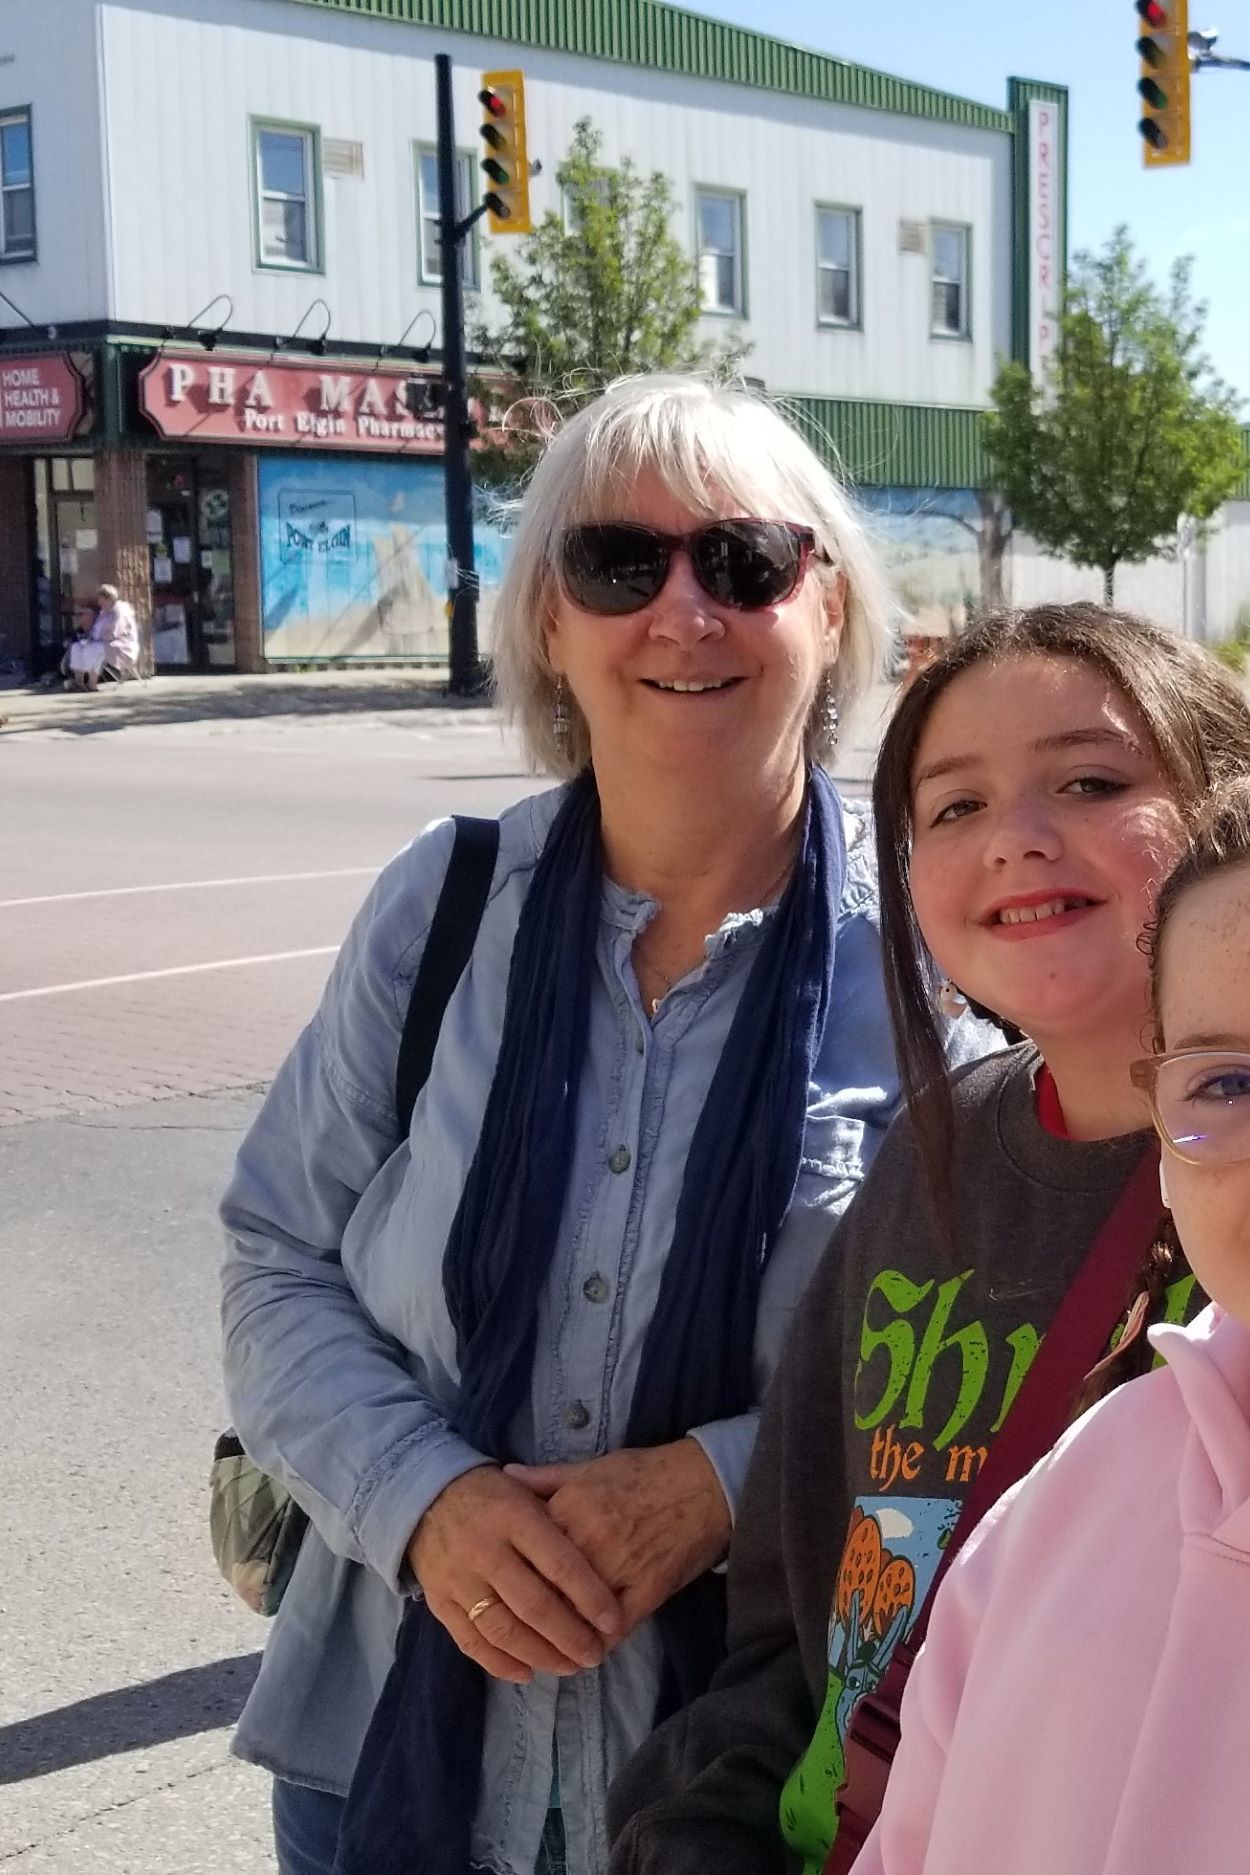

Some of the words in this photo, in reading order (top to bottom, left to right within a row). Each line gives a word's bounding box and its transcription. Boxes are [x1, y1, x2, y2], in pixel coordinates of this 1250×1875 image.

[2, 368, 40, 387] HOME
[4, 389, 49, 408] HEALTH
[5, 408, 61, 427] MOBILITY
[244, 407, 284, 431] Port
[296, 411, 347, 437] Elgin
[870, 1424, 925, 1492] the
